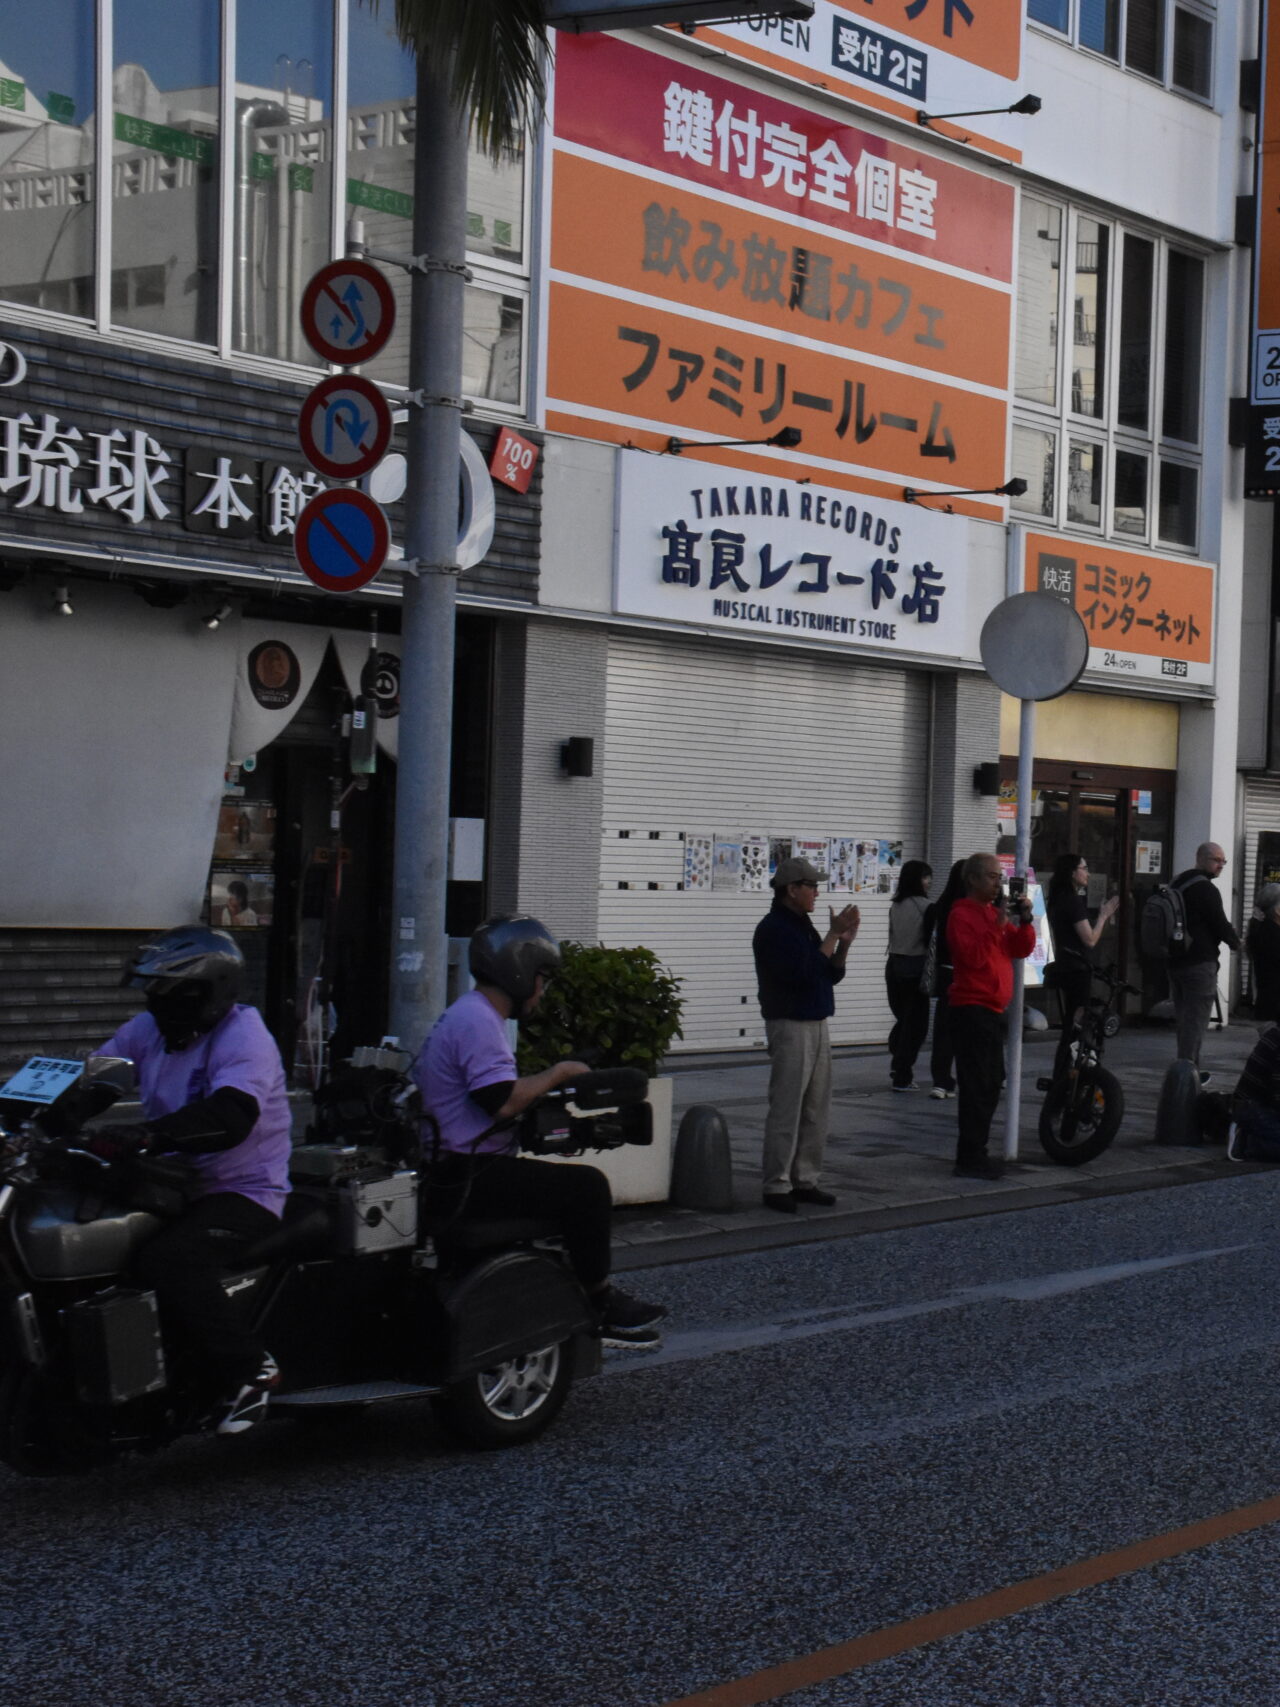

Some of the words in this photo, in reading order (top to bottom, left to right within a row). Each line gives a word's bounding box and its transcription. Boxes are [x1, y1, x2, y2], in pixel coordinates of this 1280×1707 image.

[839, 26, 884, 77] 受付
[888, 50, 923, 90] 2F
[663, 81, 938, 241] 鍵付完全個室
[641, 201, 945, 352] 飲み放題カフェ
[617, 325, 957, 464] ファミリールーム
[501, 440, 533, 471] 100
[690, 486, 790, 519] TAKARA
[800, 491, 901, 554] RECORDS
[1043, 566, 1072, 593] 快活
[1083, 563, 1152, 602] コミック
[713, 598, 772, 624] MUSICAL
[776, 607, 856, 636] INSTRUMENT
[859, 619, 897, 641] STORE
[1083, 599, 1200, 645] インターネット
